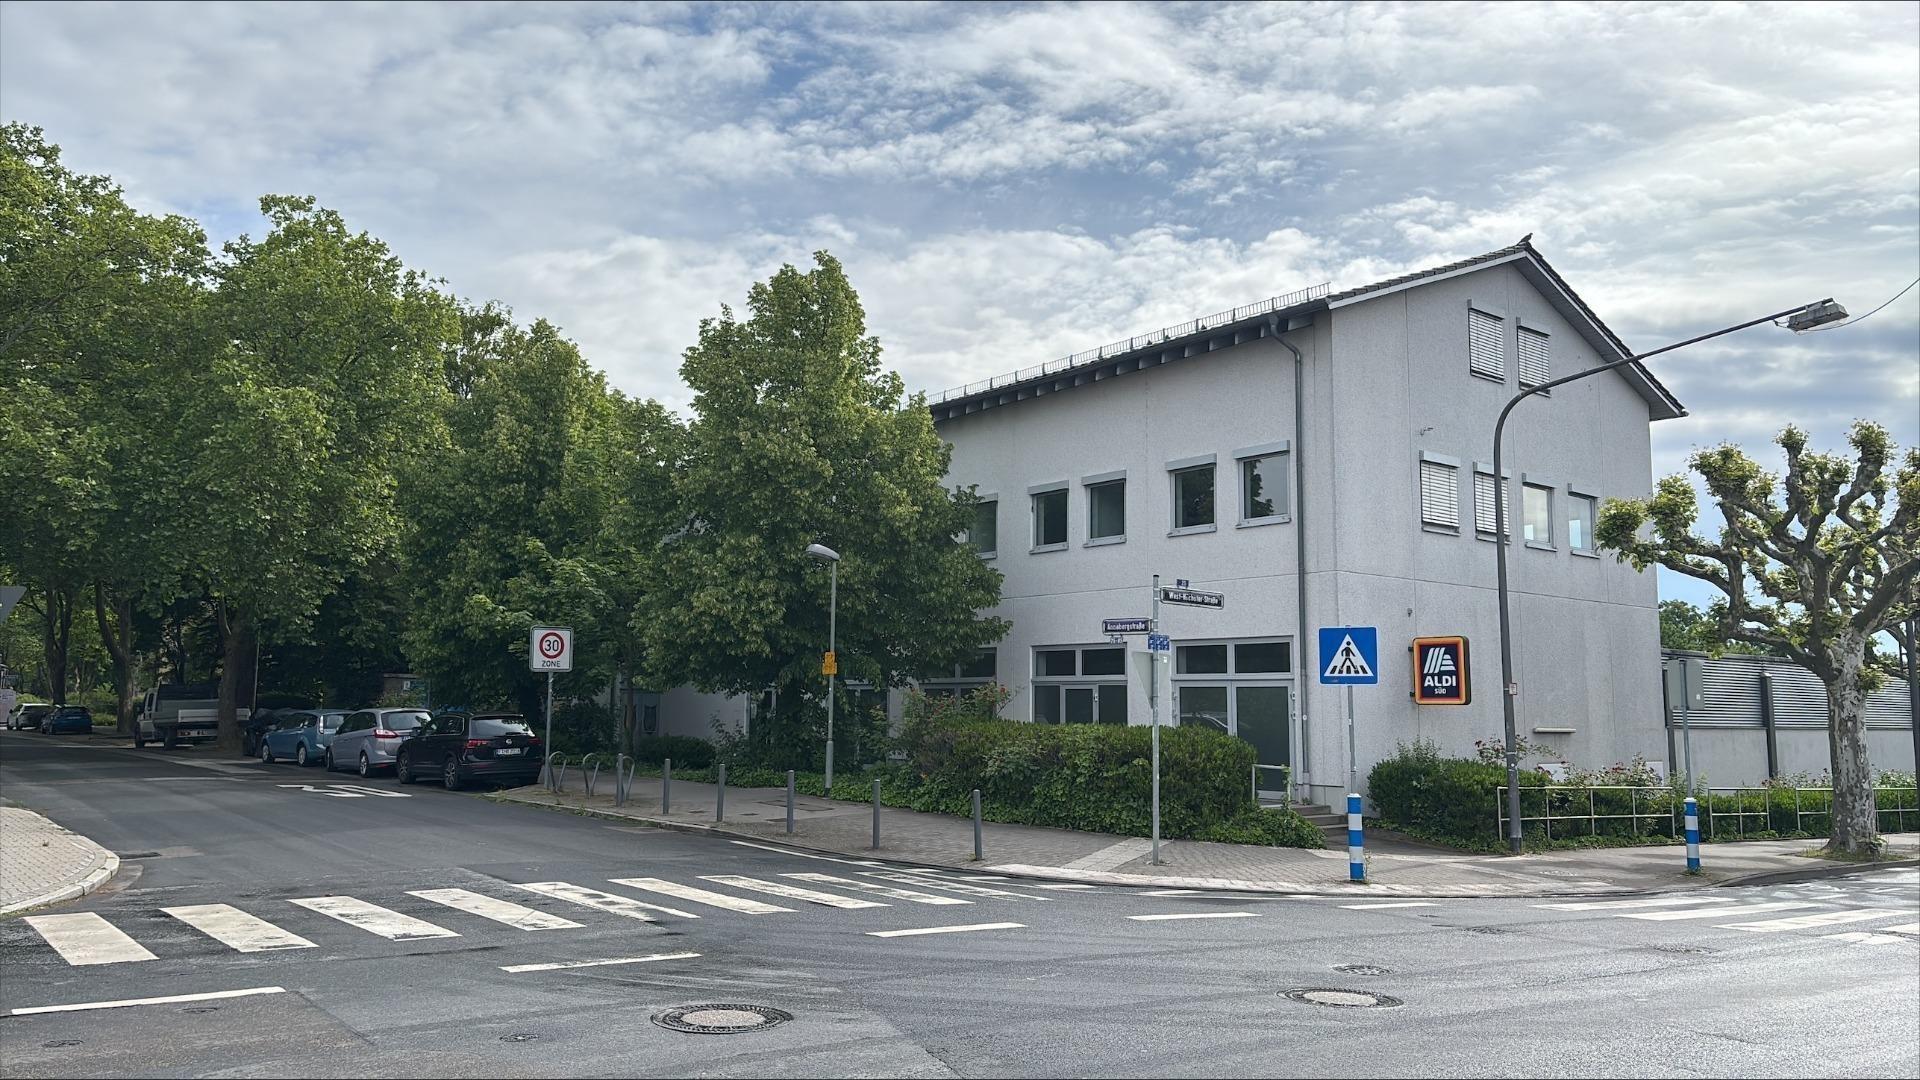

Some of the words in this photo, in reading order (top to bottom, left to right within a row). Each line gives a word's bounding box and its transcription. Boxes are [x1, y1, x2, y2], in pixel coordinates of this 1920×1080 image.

[544, 639, 559, 652] 30
[541, 660, 561, 668] ZONE
[1424, 675, 1457, 687] ALDI
[1434, 686, 1447, 694] SÜD
